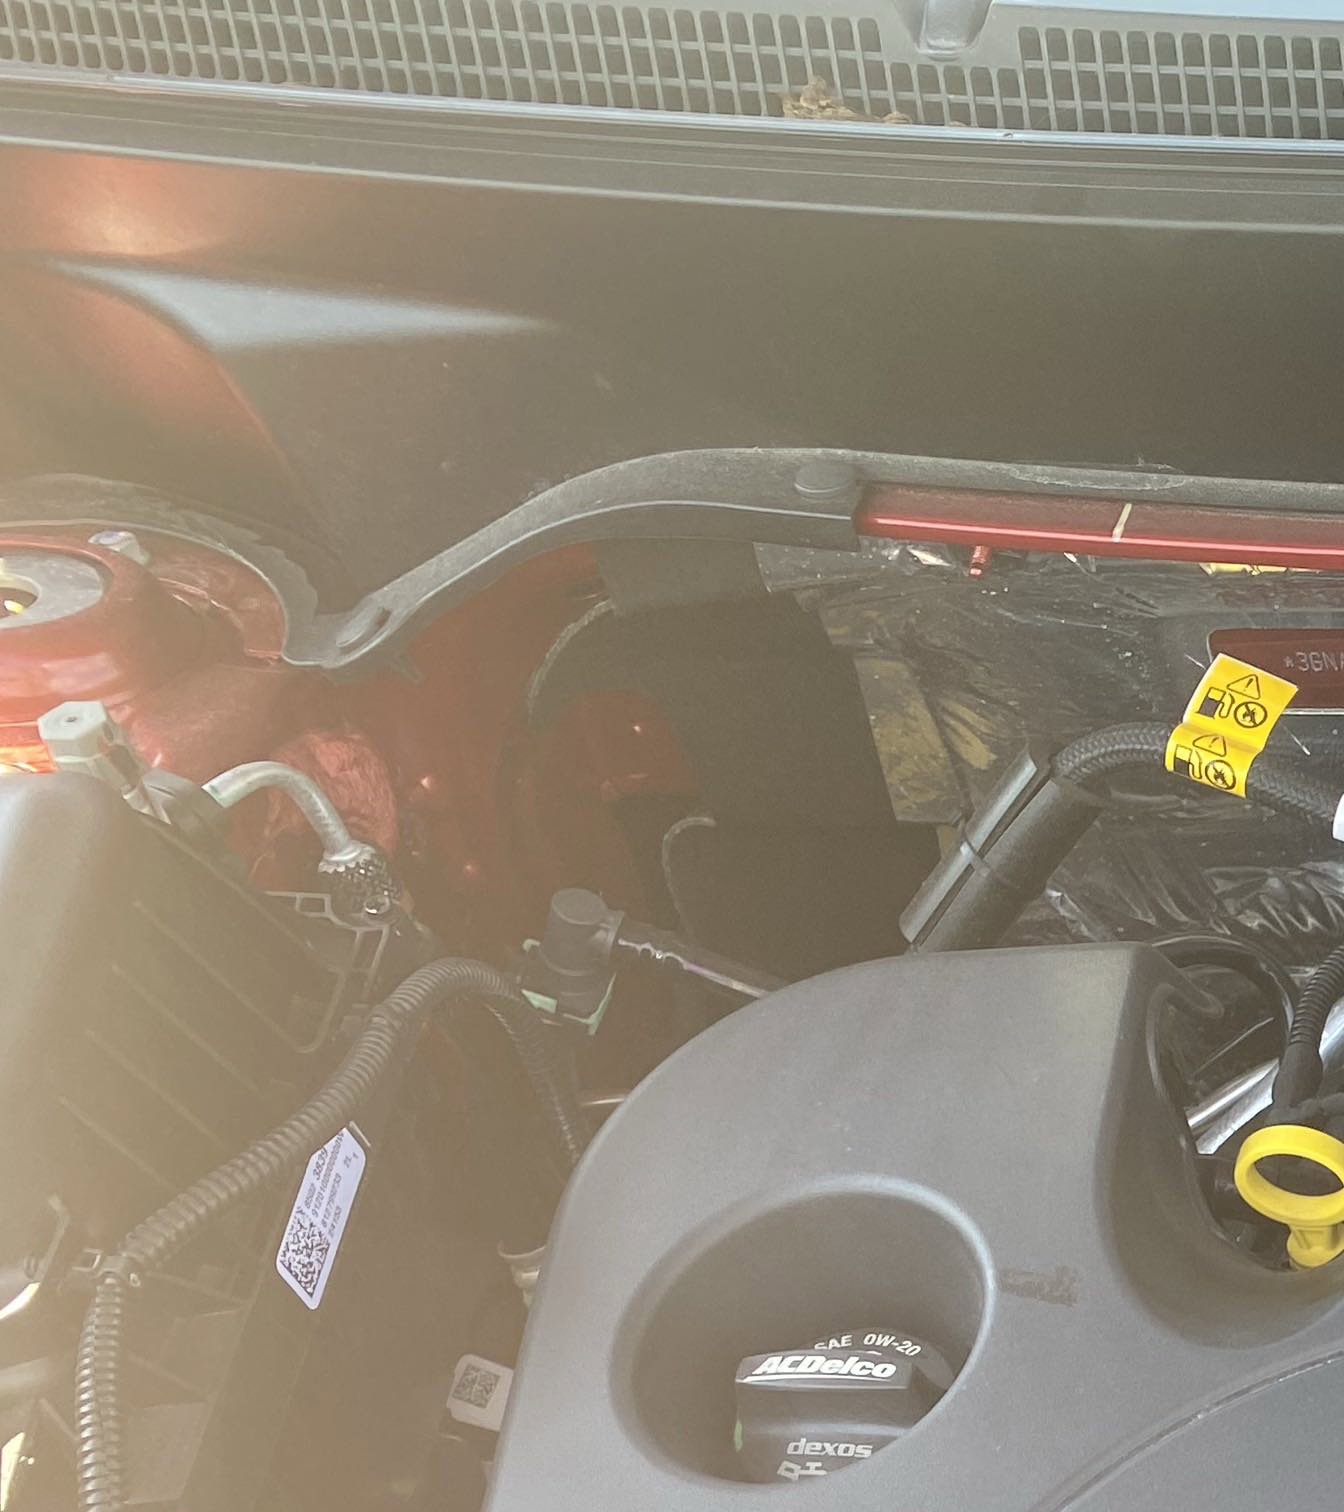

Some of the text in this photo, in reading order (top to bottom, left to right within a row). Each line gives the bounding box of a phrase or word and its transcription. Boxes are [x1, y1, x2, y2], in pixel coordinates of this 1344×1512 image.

[863, 1333, 922, 1356] 0W-20
[752, 1355, 896, 1379] ACDelco
[786, 1438, 872, 1458] dexos
